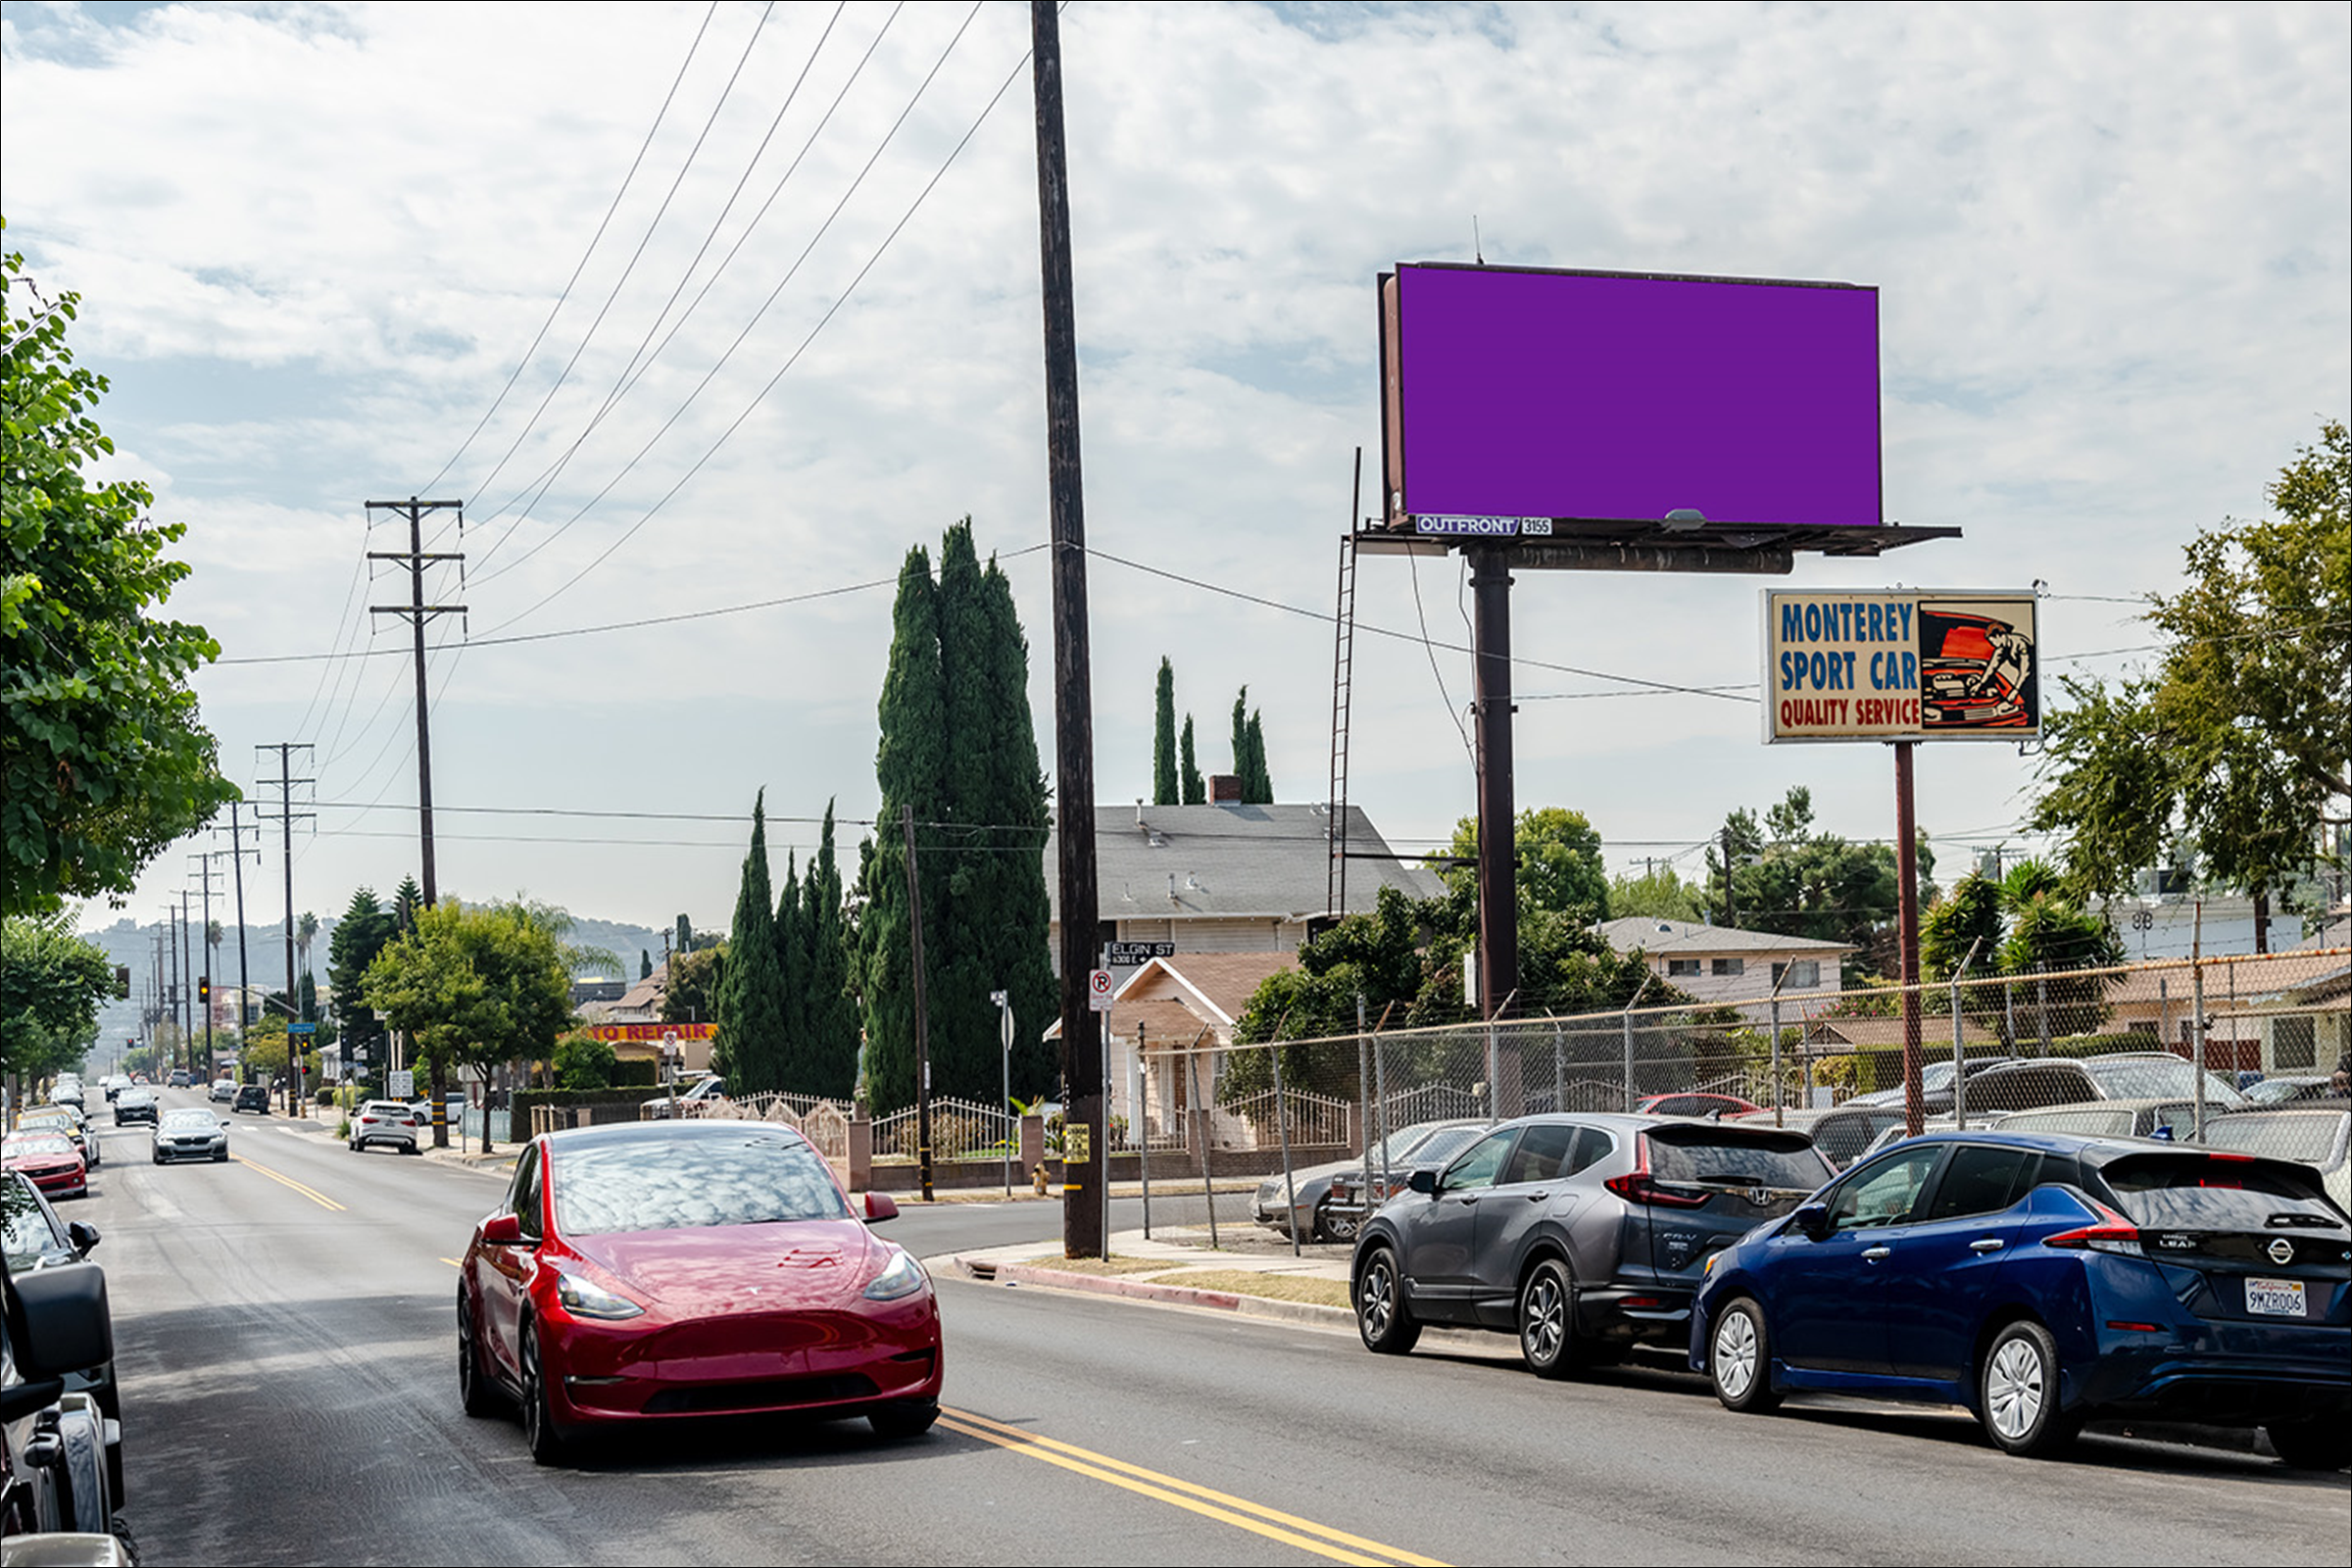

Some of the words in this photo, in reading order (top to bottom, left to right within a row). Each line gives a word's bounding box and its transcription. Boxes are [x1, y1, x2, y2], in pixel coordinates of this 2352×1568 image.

[1421, 517, 1514, 534] OUTFRONT
[1524, 518, 1549, 533] 3155
[1782, 603, 1913, 643] MONTEREY
[1780, 651, 1856, 691] SPORT
[1870, 651, 1919, 691] CAR
[1781, 699, 1849, 728] QUALITY
[1856, 699, 1920, 725] SERVICE
[1111, 943, 1151, 956] ELGIN
[1155, 943, 1173, 956] ST
[627, 1025, 710, 1041] REPAIR
[2249, 1291, 2302, 1311] 9MZR006
